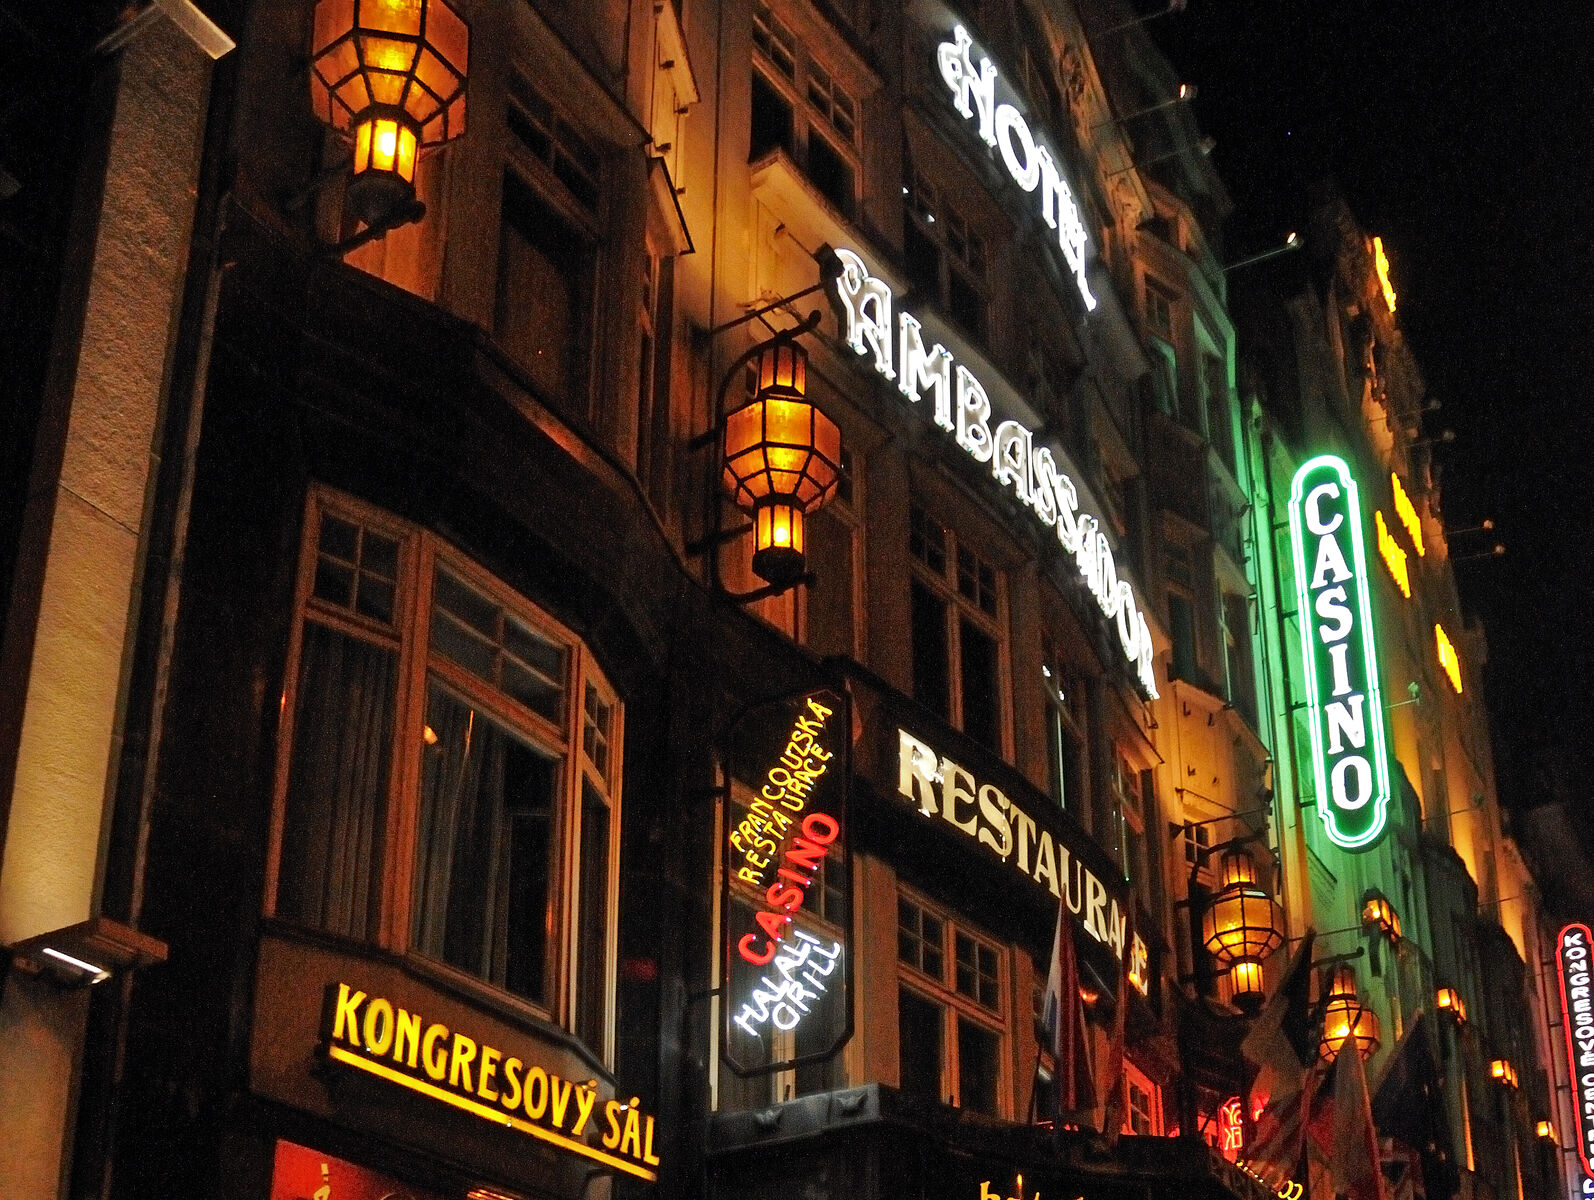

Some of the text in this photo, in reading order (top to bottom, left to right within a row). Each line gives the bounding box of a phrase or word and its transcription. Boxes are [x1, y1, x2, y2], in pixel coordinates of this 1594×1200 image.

[937, 24, 1096, 311] HOTEL
[834, 248, 1159, 699] AMBASSADOR
[1306, 482, 1372, 811] CASINO
[738, 742, 834, 884] RESTAURACE
[738, 811, 840, 964] CASINO
[898, 728, 1148, 997] RESTAURAE
[734, 928, 820, 1035] HALALI
[772, 942, 840, 1030] GRILL
[332, 983, 660, 1166] KONGRESOVÝ SÁL
